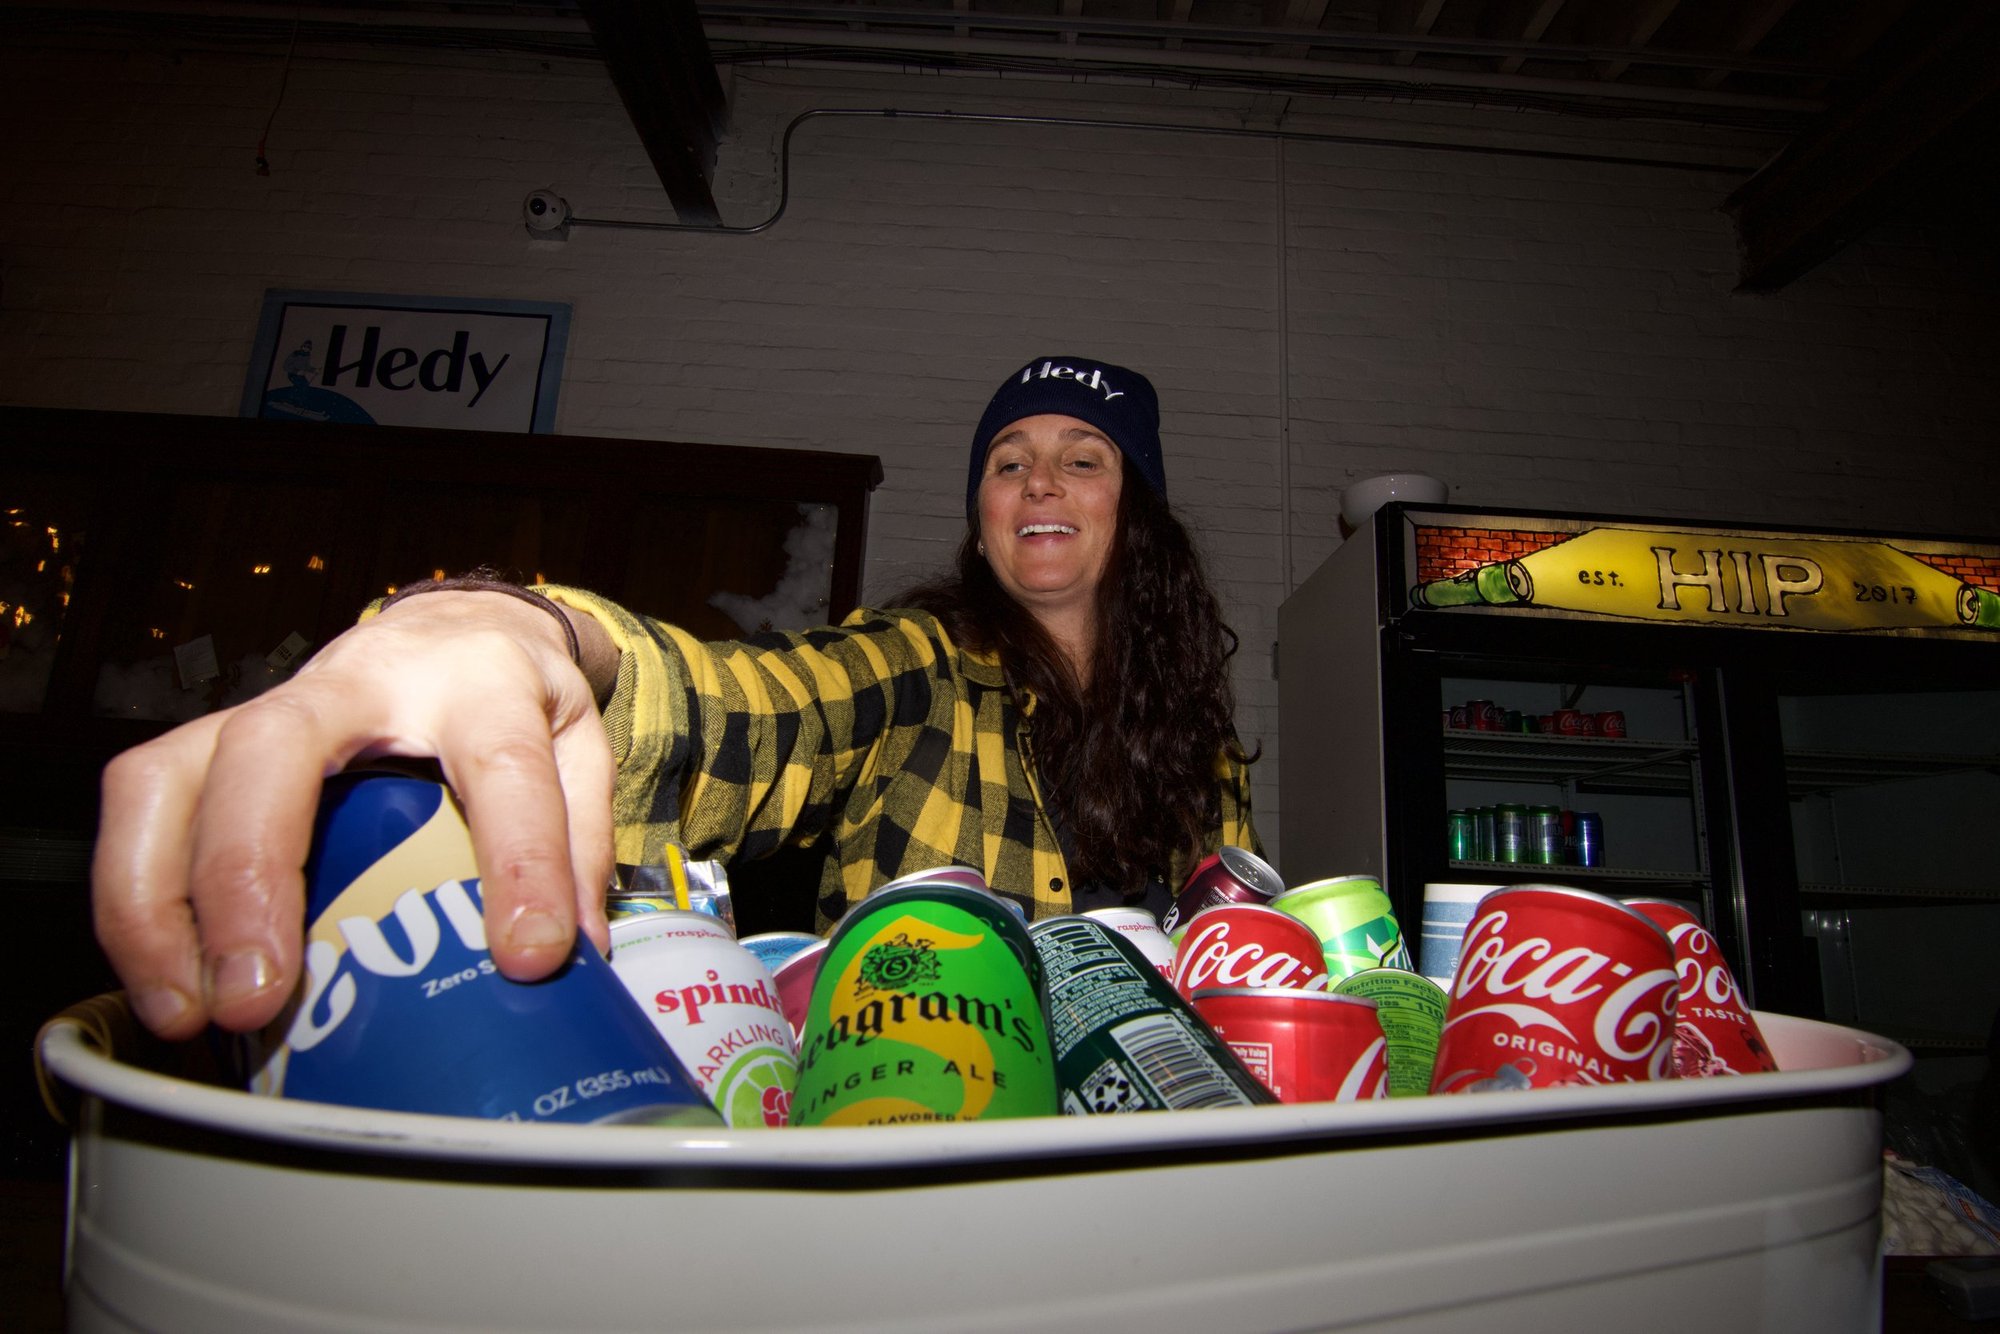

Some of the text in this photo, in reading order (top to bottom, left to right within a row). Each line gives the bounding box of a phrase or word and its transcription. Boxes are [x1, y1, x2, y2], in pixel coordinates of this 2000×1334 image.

[321, 324, 510, 408] Hedy
[1021, 361, 1124, 400] Hedy
[1578, 569, 1624, 588] est.
[1650, 546, 1824, 617] HIP
[1852, 581, 1918, 604] 2017
[1174, 921, 1329, 991] Coca-
[421, 967, 478, 998] Zero
[654, 969, 783, 1026] spindr
[1456, 910, 1680, 1081] Coca-C
[1691, 1007, 1747, 1025] TASTE
[695, 1023, 785, 1089] ARKLING
[943, 1060, 1007, 1089] ALE
[1493, 1033, 1616, 1081] ORIGINAL
[533, 1086, 577, 1117] OZ
[575, 1069, 632, 1099] (355
